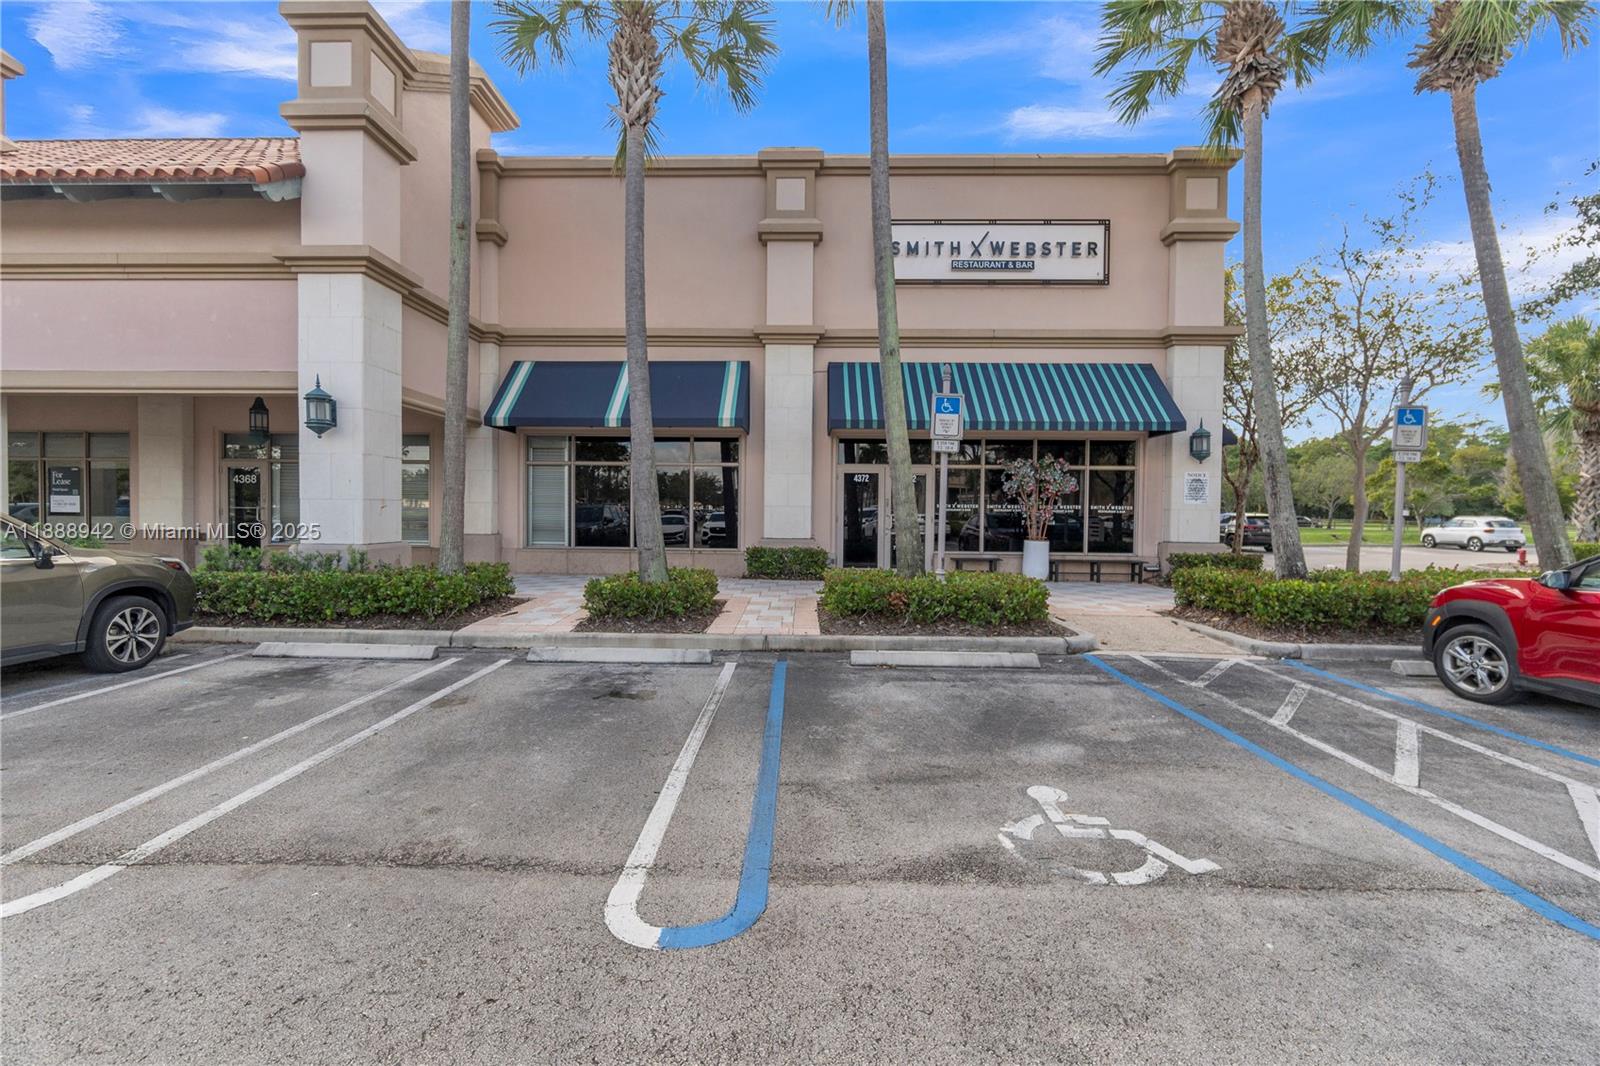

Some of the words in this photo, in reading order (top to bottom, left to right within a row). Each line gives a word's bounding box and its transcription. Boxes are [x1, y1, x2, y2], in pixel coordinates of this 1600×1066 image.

[891, 241, 961, 257] SMITH
[989, 241, 1099, 257] WEBSTER
[952, 261, 1007, 269] RESTAURANT
[1008, 261, 1014, 269] &
[1015, 261, 1033, 269] BAR
[52, 470, 64, 479] For
[233, 474, 257, 484] 4368
[853, 474, 870, 483] 4372
[52, 477, 71, 486] Lease
